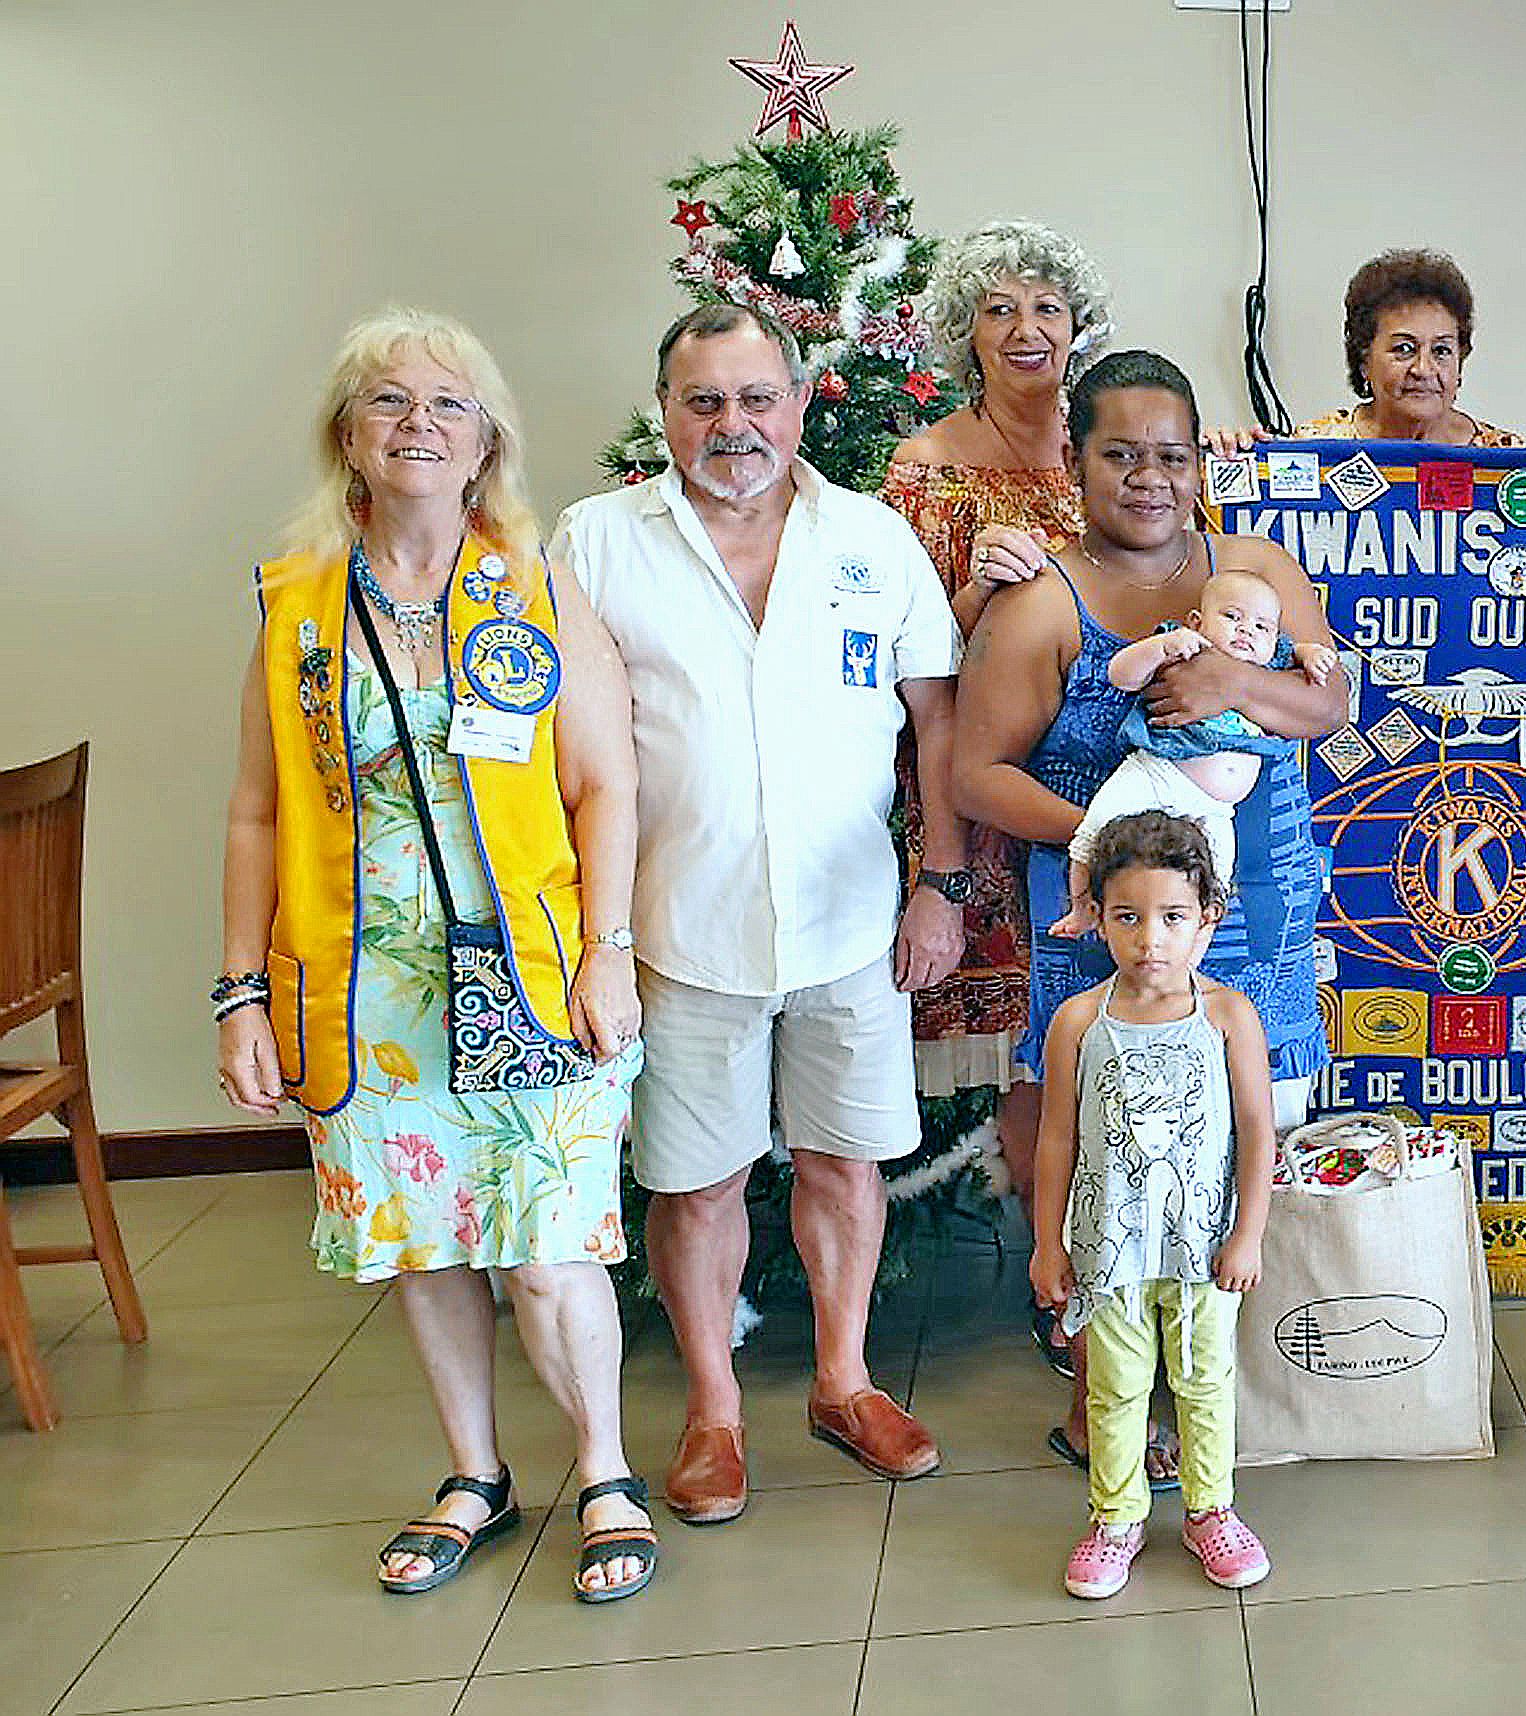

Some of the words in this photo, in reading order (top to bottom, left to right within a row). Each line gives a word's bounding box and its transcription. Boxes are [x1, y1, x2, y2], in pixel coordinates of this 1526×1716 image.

[479, 628, 531, 647] LIONS
[1354, 596, 1440, 648] SUD
[1415, 800, 1517, 838] KIWANIS
[1437, 822, 1502, 915] K
[1367, 1071, 1406, 1104] DE
